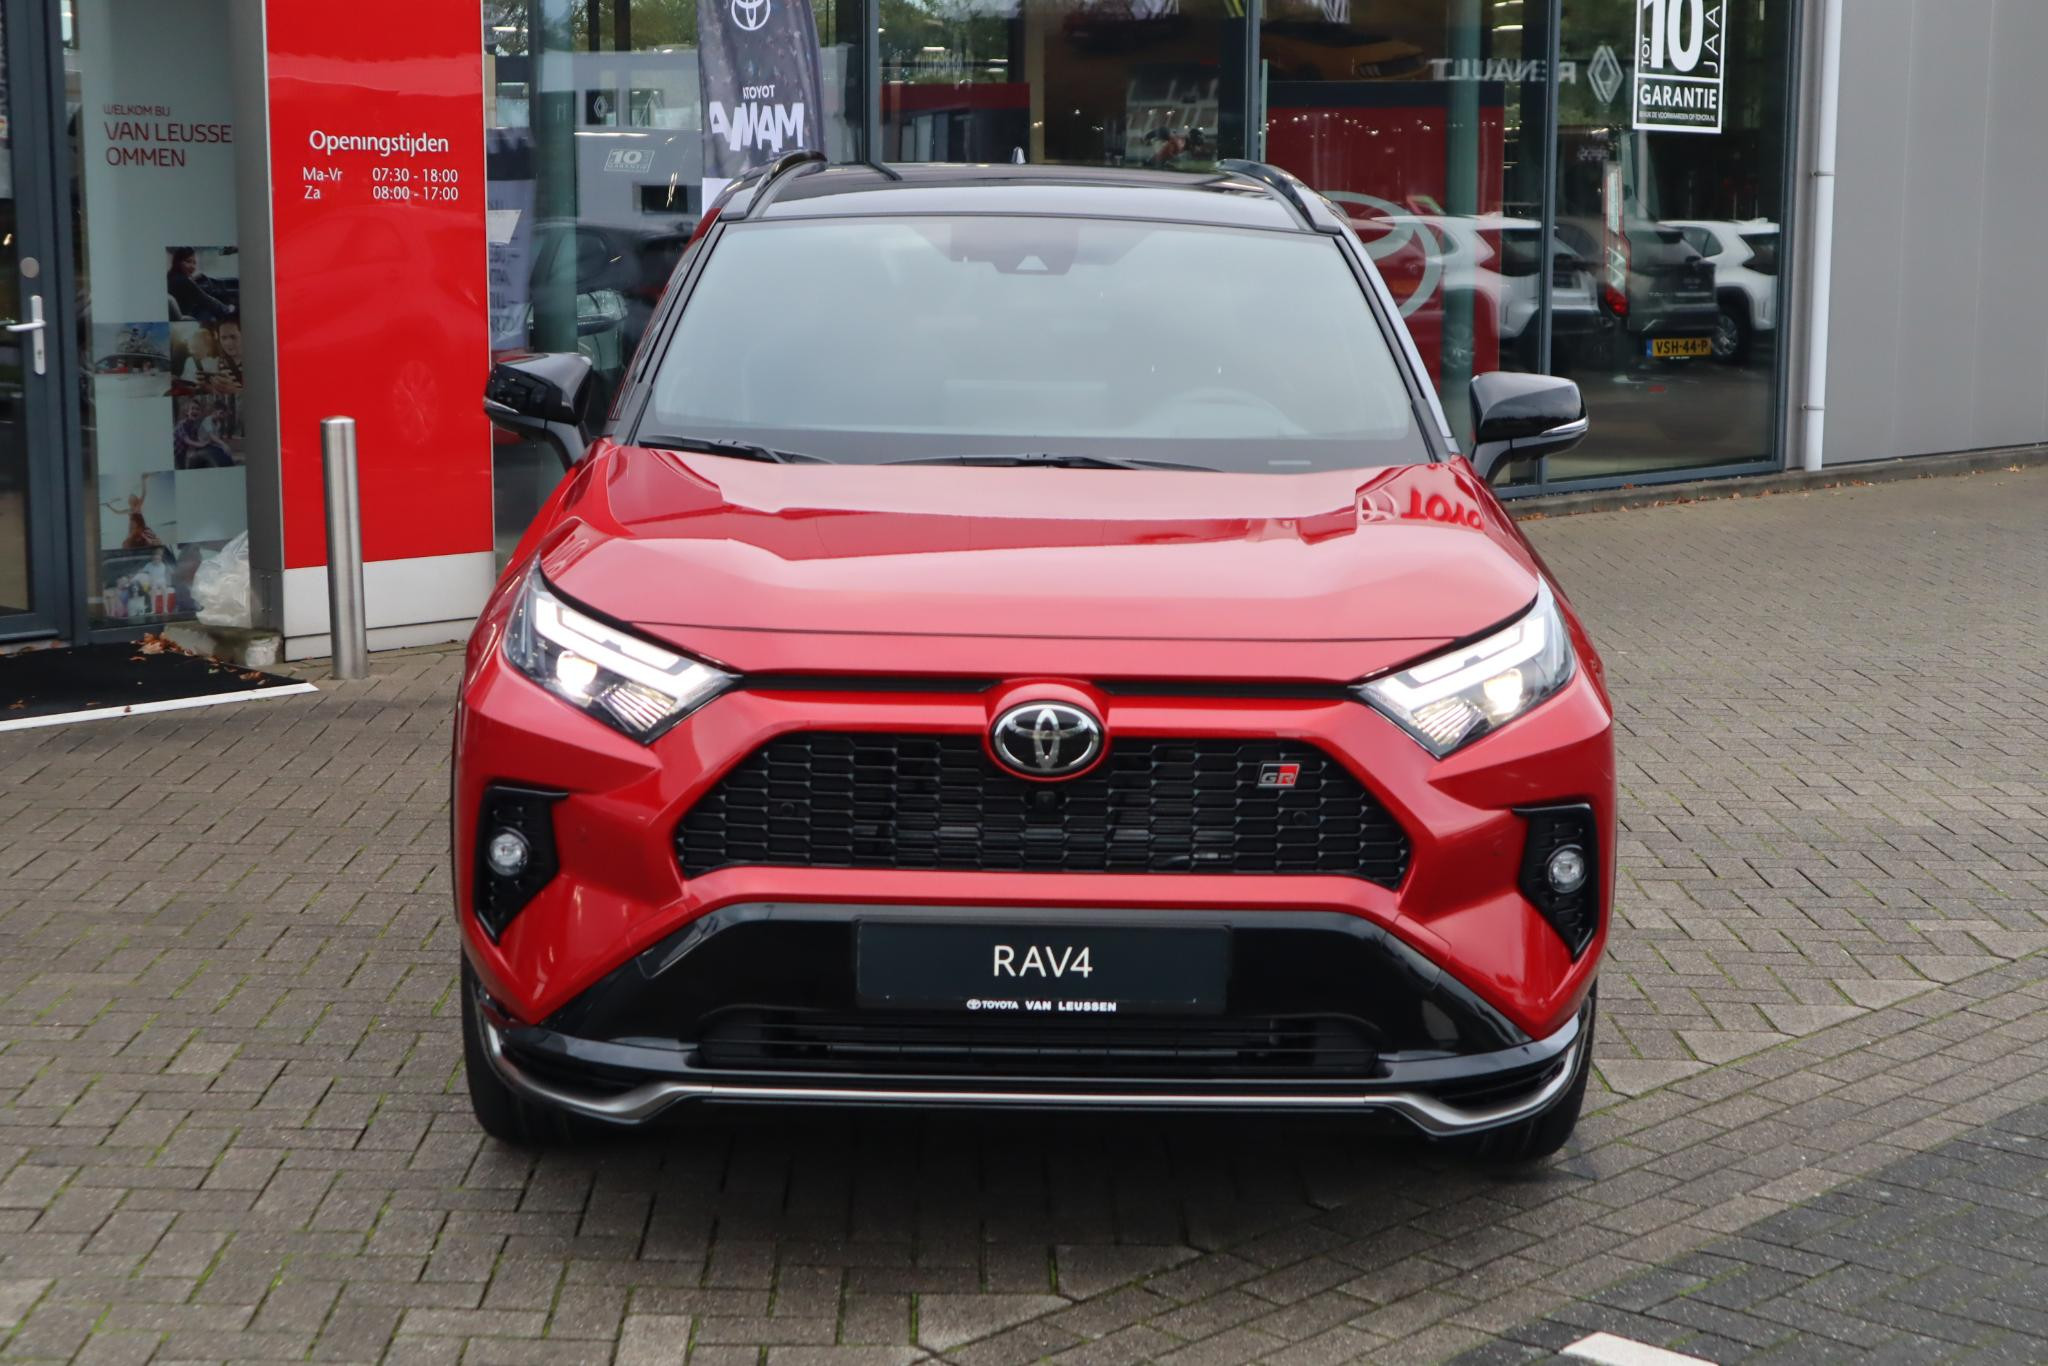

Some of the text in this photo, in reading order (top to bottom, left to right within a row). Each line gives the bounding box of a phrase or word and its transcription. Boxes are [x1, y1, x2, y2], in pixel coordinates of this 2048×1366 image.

[1643, 0, 1704, 72] 10
[1641, 35, 1650, 67] TOT
[1640, 84, 1717, 109] GARANTIE
[103, 104, 152, 116] WELKOM
[104, 122, 149, 141] VAN
[309, 130, 449, 157] Openingstijden
[106, 147, 185, 167] OMMEN
[612, 150, 642, 164] 10
[303, 167, 343, 181] Ma-Vr
[372, 168, 409, 182] 07:30
[423, 169, 458, 183] 18:00
[304, 185, 321, 199] Za
[373, 186, 410, 200] 08:00
[424, 187, 458, 200] 17:00
[1656, 339, 1708, 355] VSH-44-P
[1261, 772, 1296, 785] GR
[993, 944, 1094, 979] RAV4
[982, 1000, 1117, 1012] TOYOTA VAN LEUSSEN
